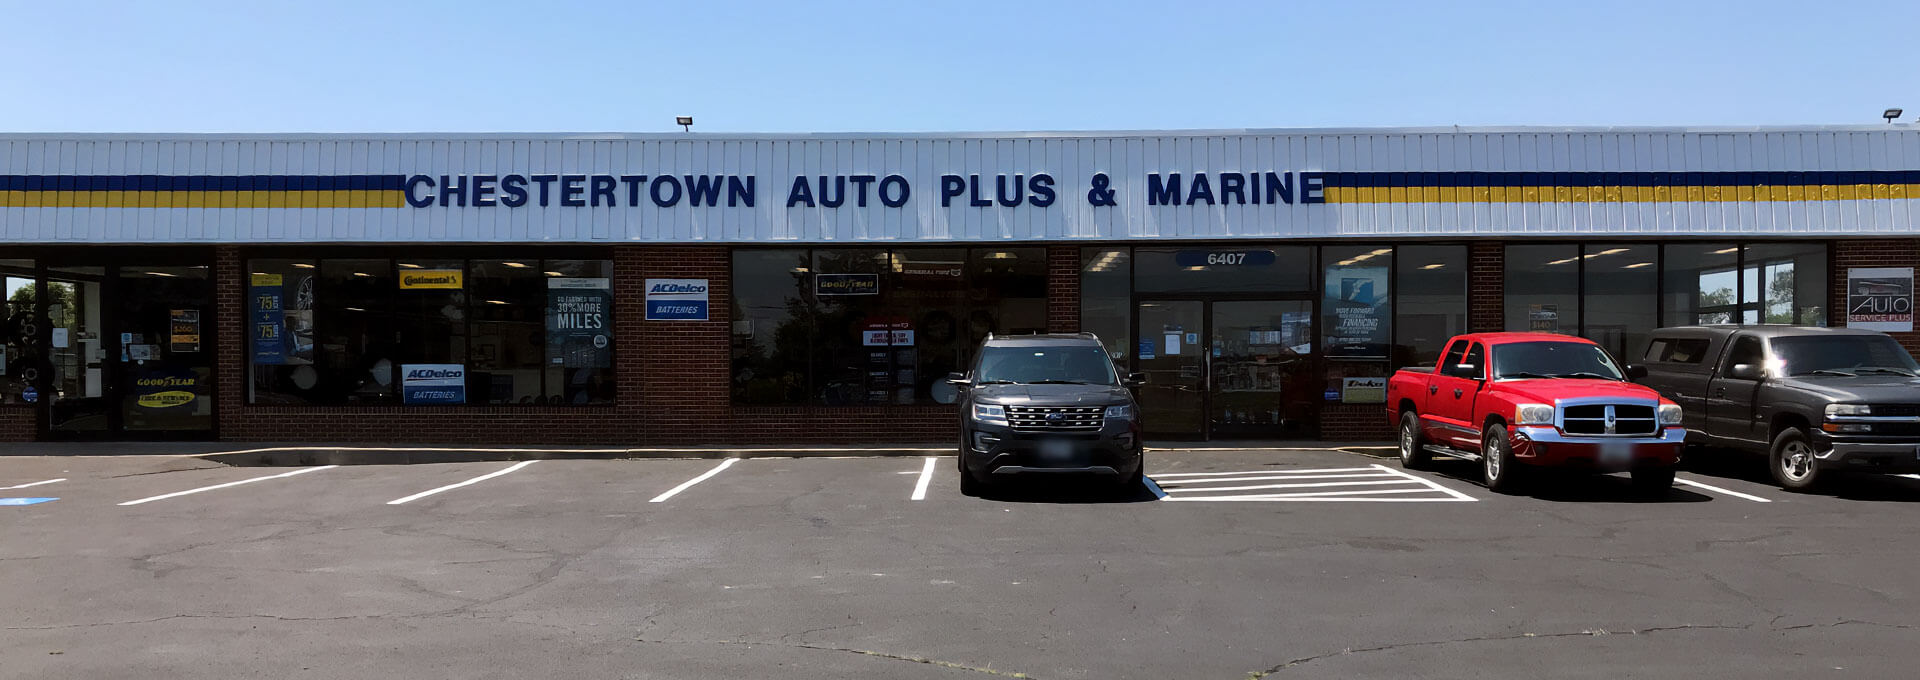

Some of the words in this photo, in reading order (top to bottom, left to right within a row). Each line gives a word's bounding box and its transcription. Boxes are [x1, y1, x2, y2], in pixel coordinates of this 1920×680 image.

[405, 174, 755, 208] CHESTERTOWN
[787, 174, 910, 208] AUTO
[942, 173, 1056, 208] PLUS
[1088, 173, 1118, 207] &
[1147, 172, 1325, 206] MARINE
[1207, 253, 1246, 265] 6407
[404, 276, 449, 286] Continental
[651, 284, 706, 292] ACDelco
[576, 303, 601, 313] MORE
[656, 305, 698, 314] BATTERIES
[1851, 297, 1909, 313] AUTO
[557, 313, 602, 329] MILES
[1850, 314, 1888, 322] SERVICE
[1889, 314, 1911, 322] PLUS
[407, 369, 462, 378] ACDelco
[137, 376, 195, 387] GOODYEAR
[413, 391, 456, 400] BATTERIES
